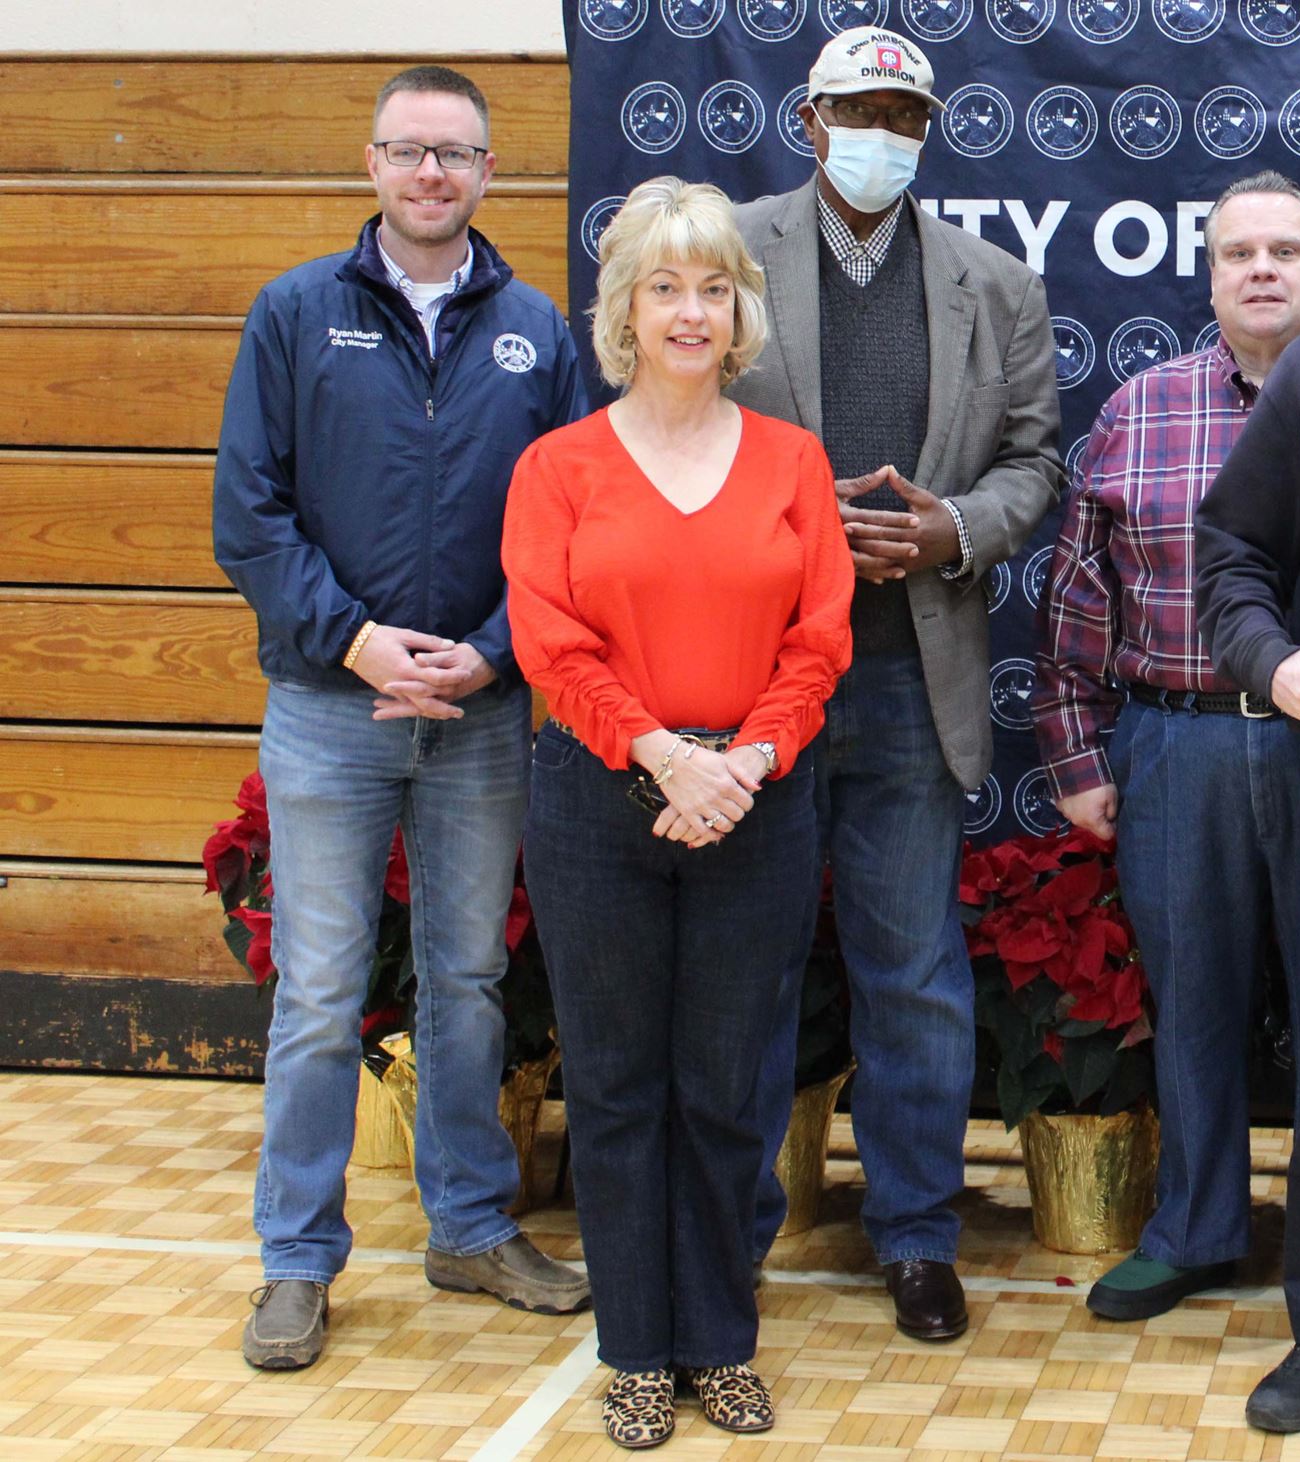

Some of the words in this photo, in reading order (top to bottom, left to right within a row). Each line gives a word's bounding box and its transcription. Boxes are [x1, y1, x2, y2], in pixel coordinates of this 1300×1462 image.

[870, 34, 922, 66] AIRBORNE
[862, 68, 916, 85] DIVISION
[328, 328, 353, 339] Ryan
[354, 329, 383, 339] Martin
[331, 338, 346, 347] City
[347, 340, 378, 349] Manager
